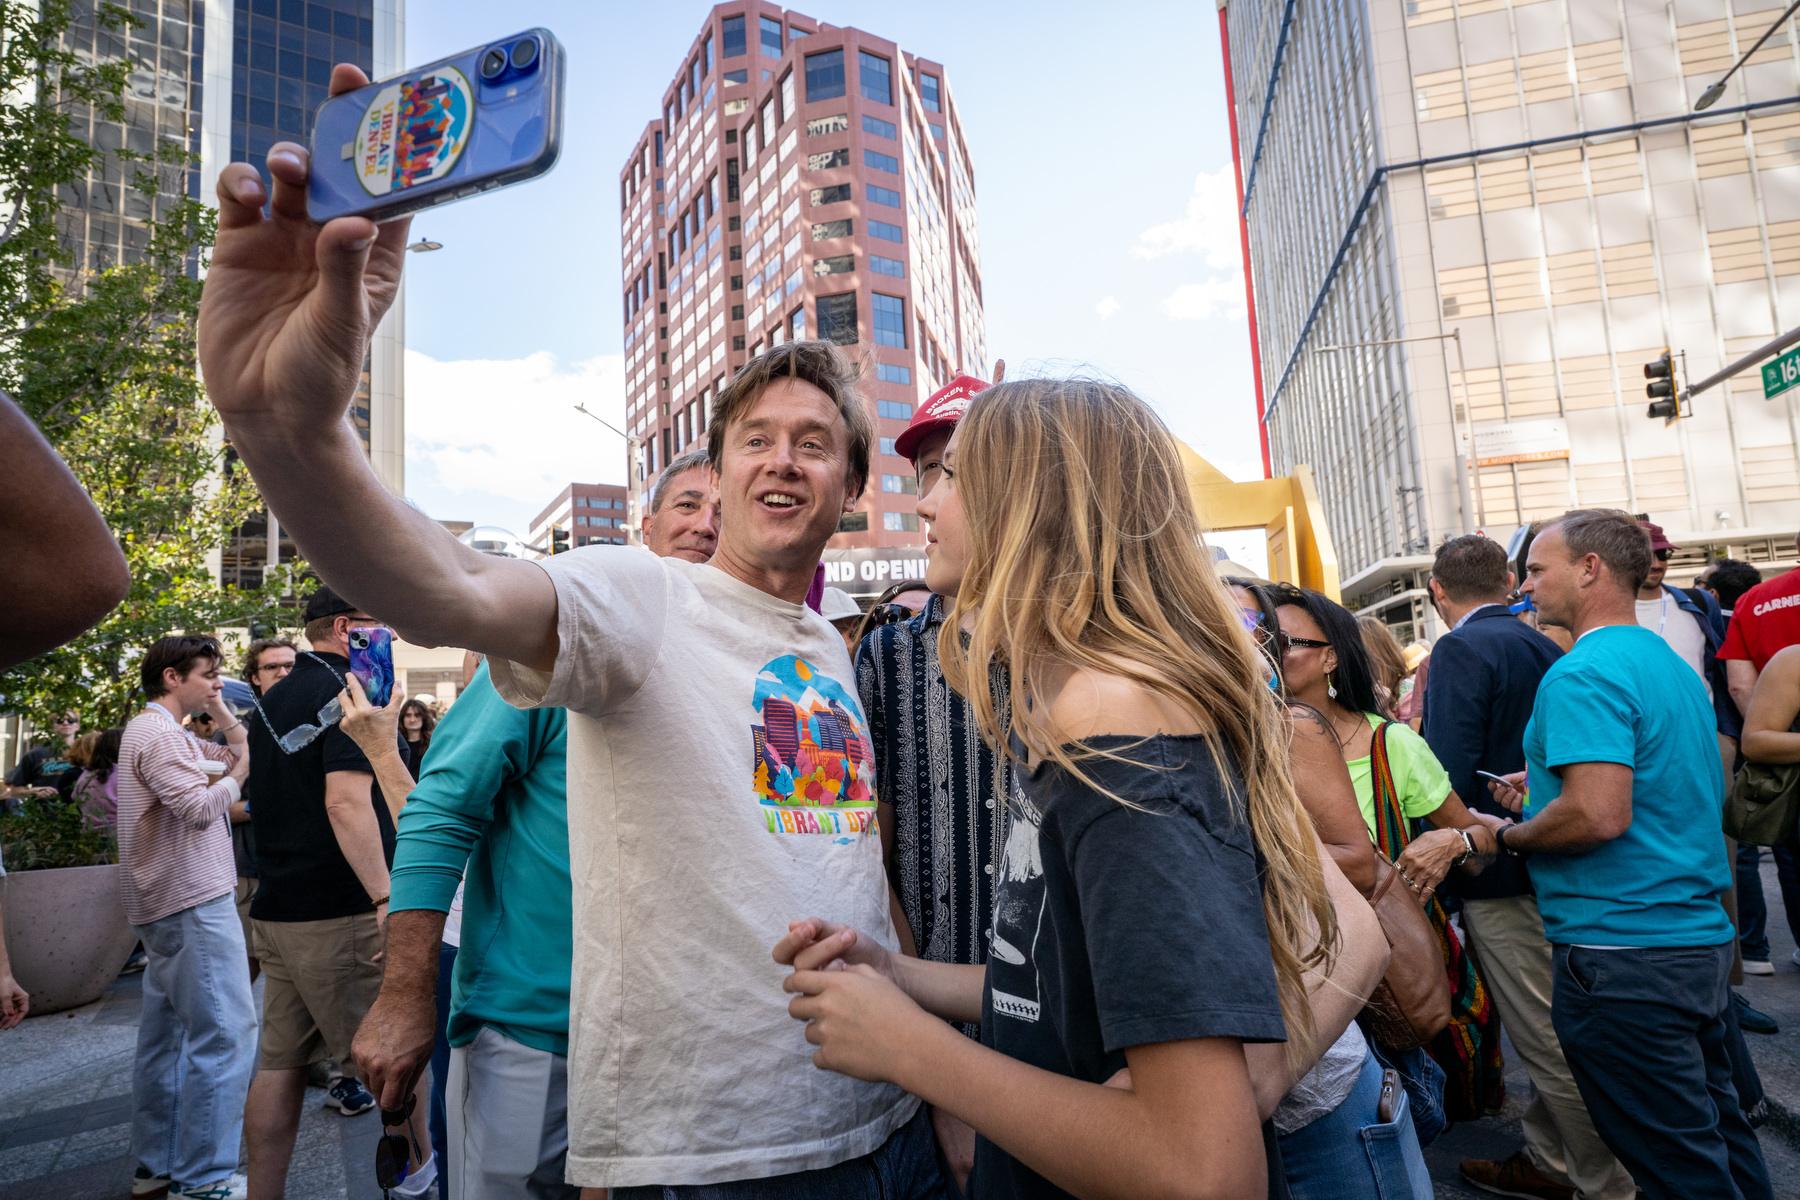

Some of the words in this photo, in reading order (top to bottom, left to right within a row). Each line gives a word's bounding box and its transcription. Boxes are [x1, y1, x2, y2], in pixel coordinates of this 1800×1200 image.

[364, 110, 380, 177] DENVER
[377, 101, 395, 176] VIBRANT
[925, 386, 964, 414] BROKEN
[860, 559, 929, 581] OPENI
[764, 809, 840, 834] VIBRANT
